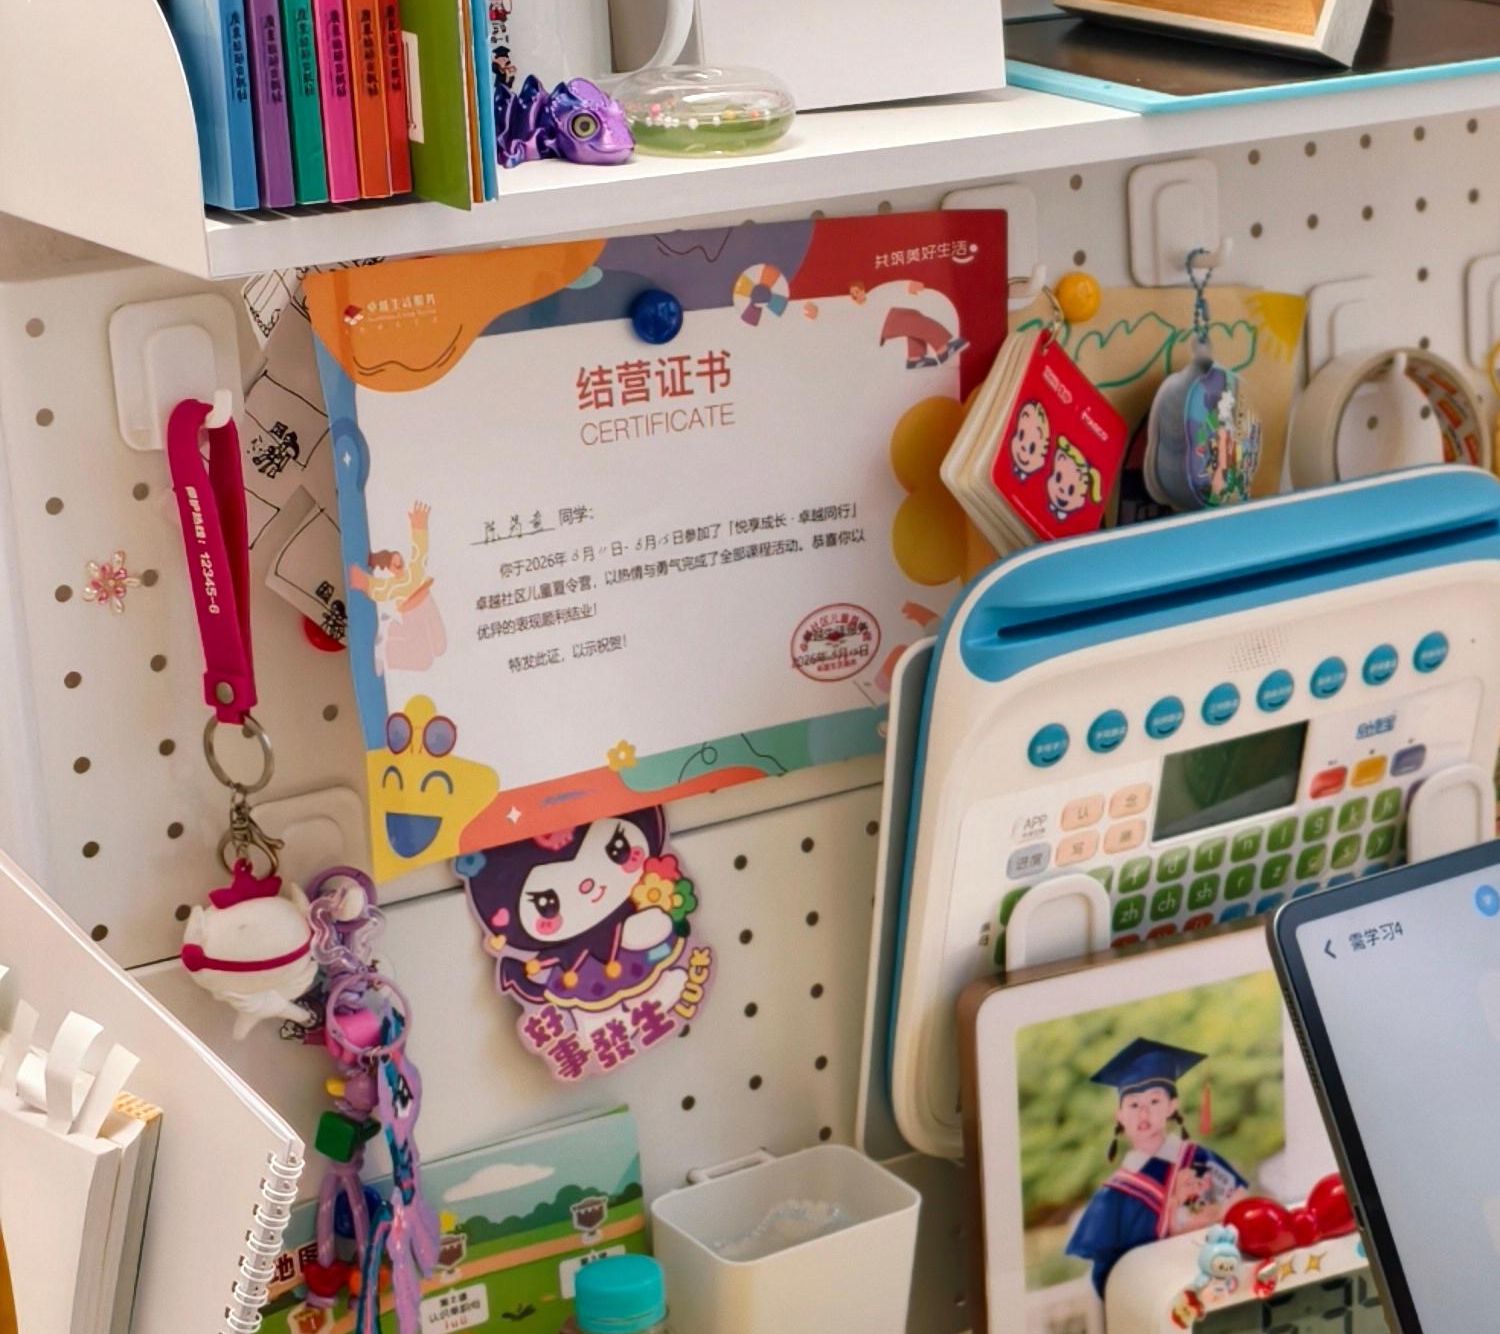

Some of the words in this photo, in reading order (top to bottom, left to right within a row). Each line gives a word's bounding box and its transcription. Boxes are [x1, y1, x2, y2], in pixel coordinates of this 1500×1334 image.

[875, 240, 968, 269] 共筑美好生活
[575, 350, 731, 410] 结营证书
[580, 402, 736, 446] CERTIFICATE
[1023, 813, 1048, 831] APP
[1120, 903, 1139, 923] zh
[1158, 893, 1176, 912] ch
[1195, 882, 1212, 902] sh
[673, 946, 712, 1019] LUCK
[524, 1000, 675, 1078] 好事發生
